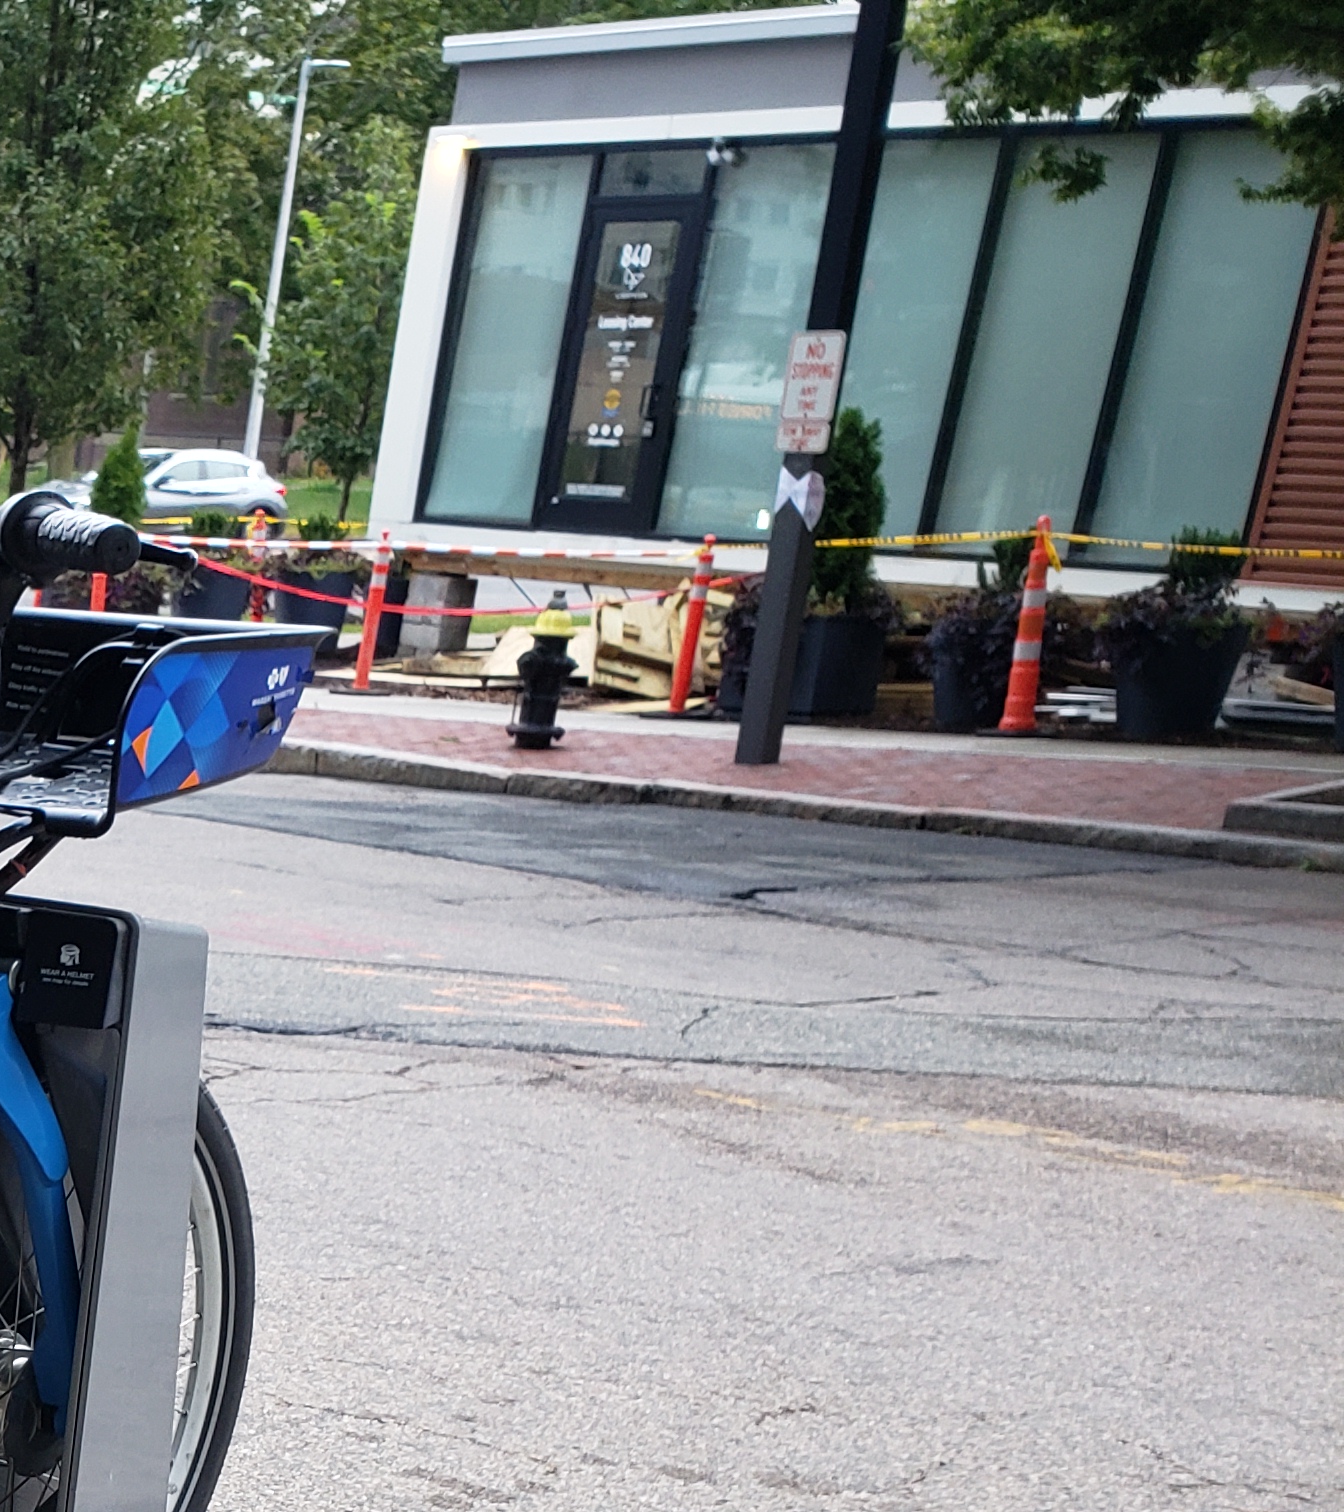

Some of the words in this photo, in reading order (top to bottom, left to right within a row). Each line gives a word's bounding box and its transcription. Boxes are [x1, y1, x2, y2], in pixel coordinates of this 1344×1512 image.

[620, 242, 652, 268] 840
[806, 342, 826, 360] NO
[791, 362, 835, 380] STOPPING
[40, 968, 60, 976] WEAR
[67, 971, 95, 981] HELMET
